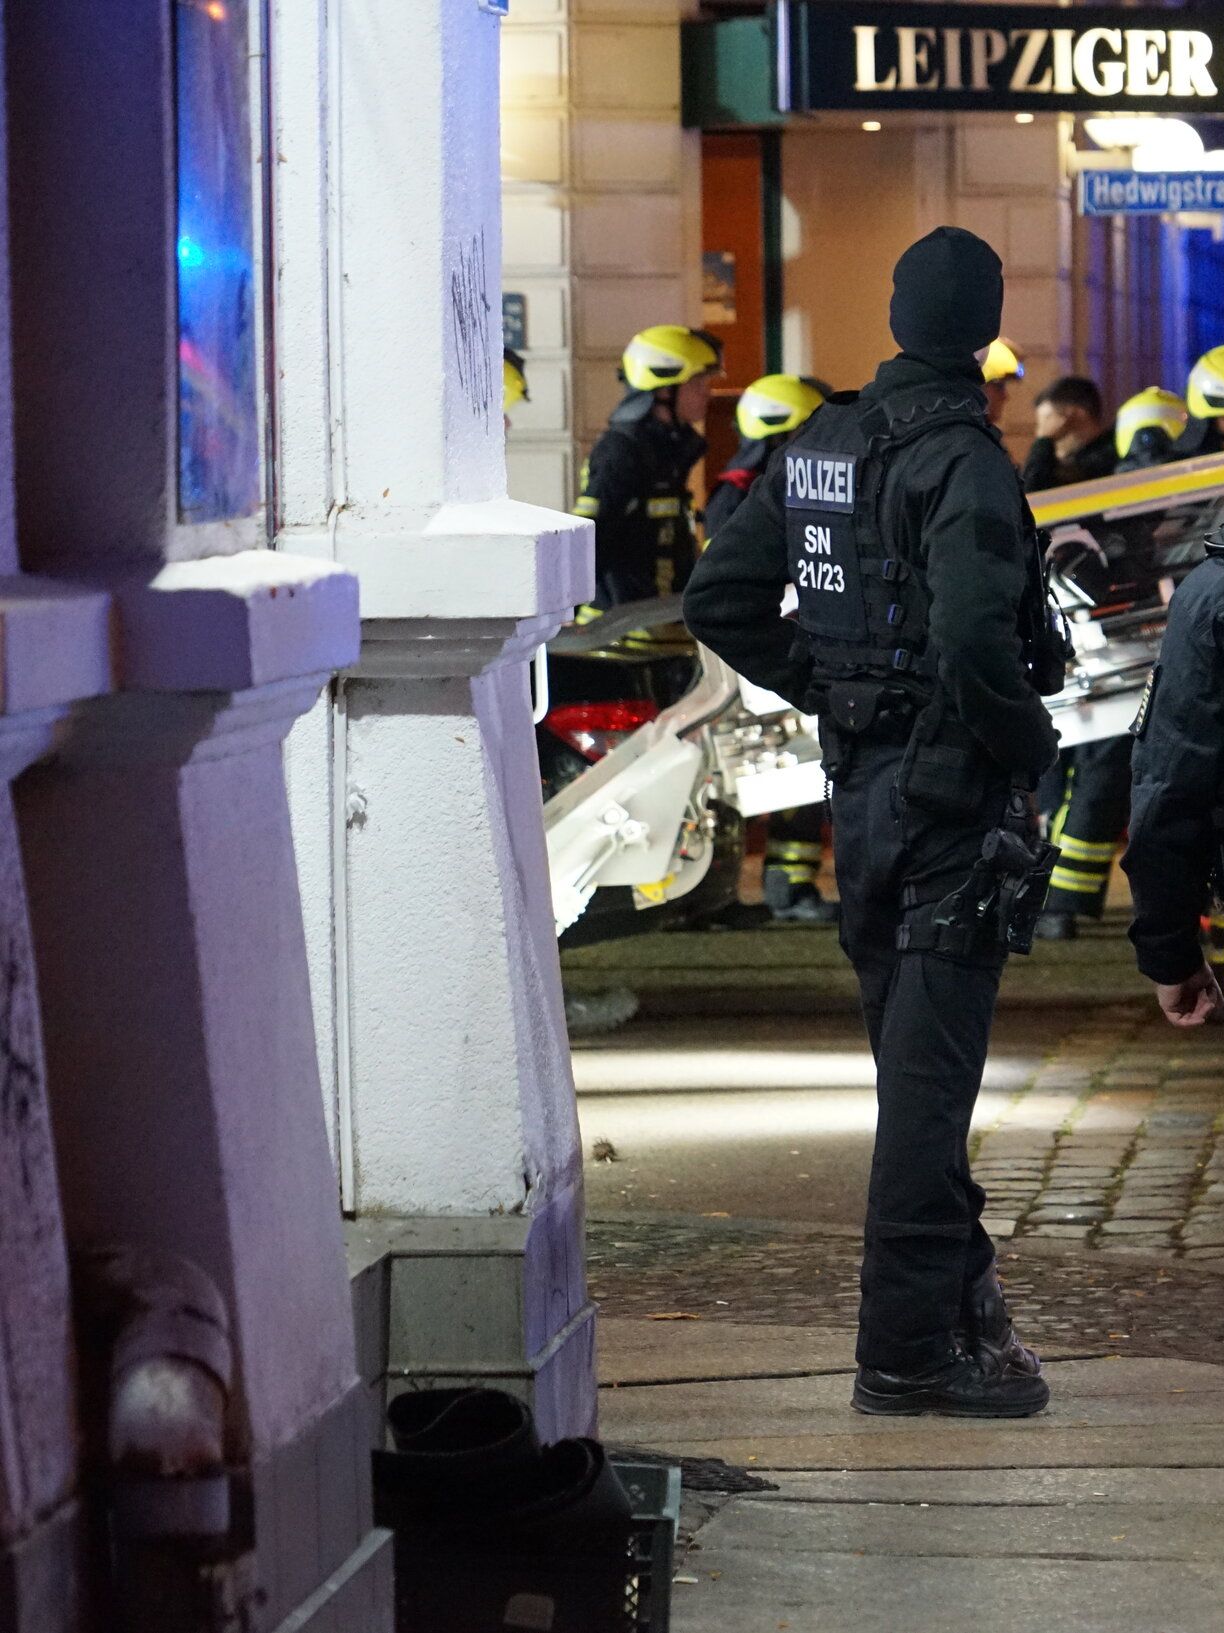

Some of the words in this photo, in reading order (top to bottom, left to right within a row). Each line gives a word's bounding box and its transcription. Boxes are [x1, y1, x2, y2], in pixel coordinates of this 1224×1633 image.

[853, 25, 1219, 98] LEIPZIGER
[786, 456, 853, 504] POLIZEI
[804, 524, 831, 555] SN
[798, 559, 845, 593] 21/23
